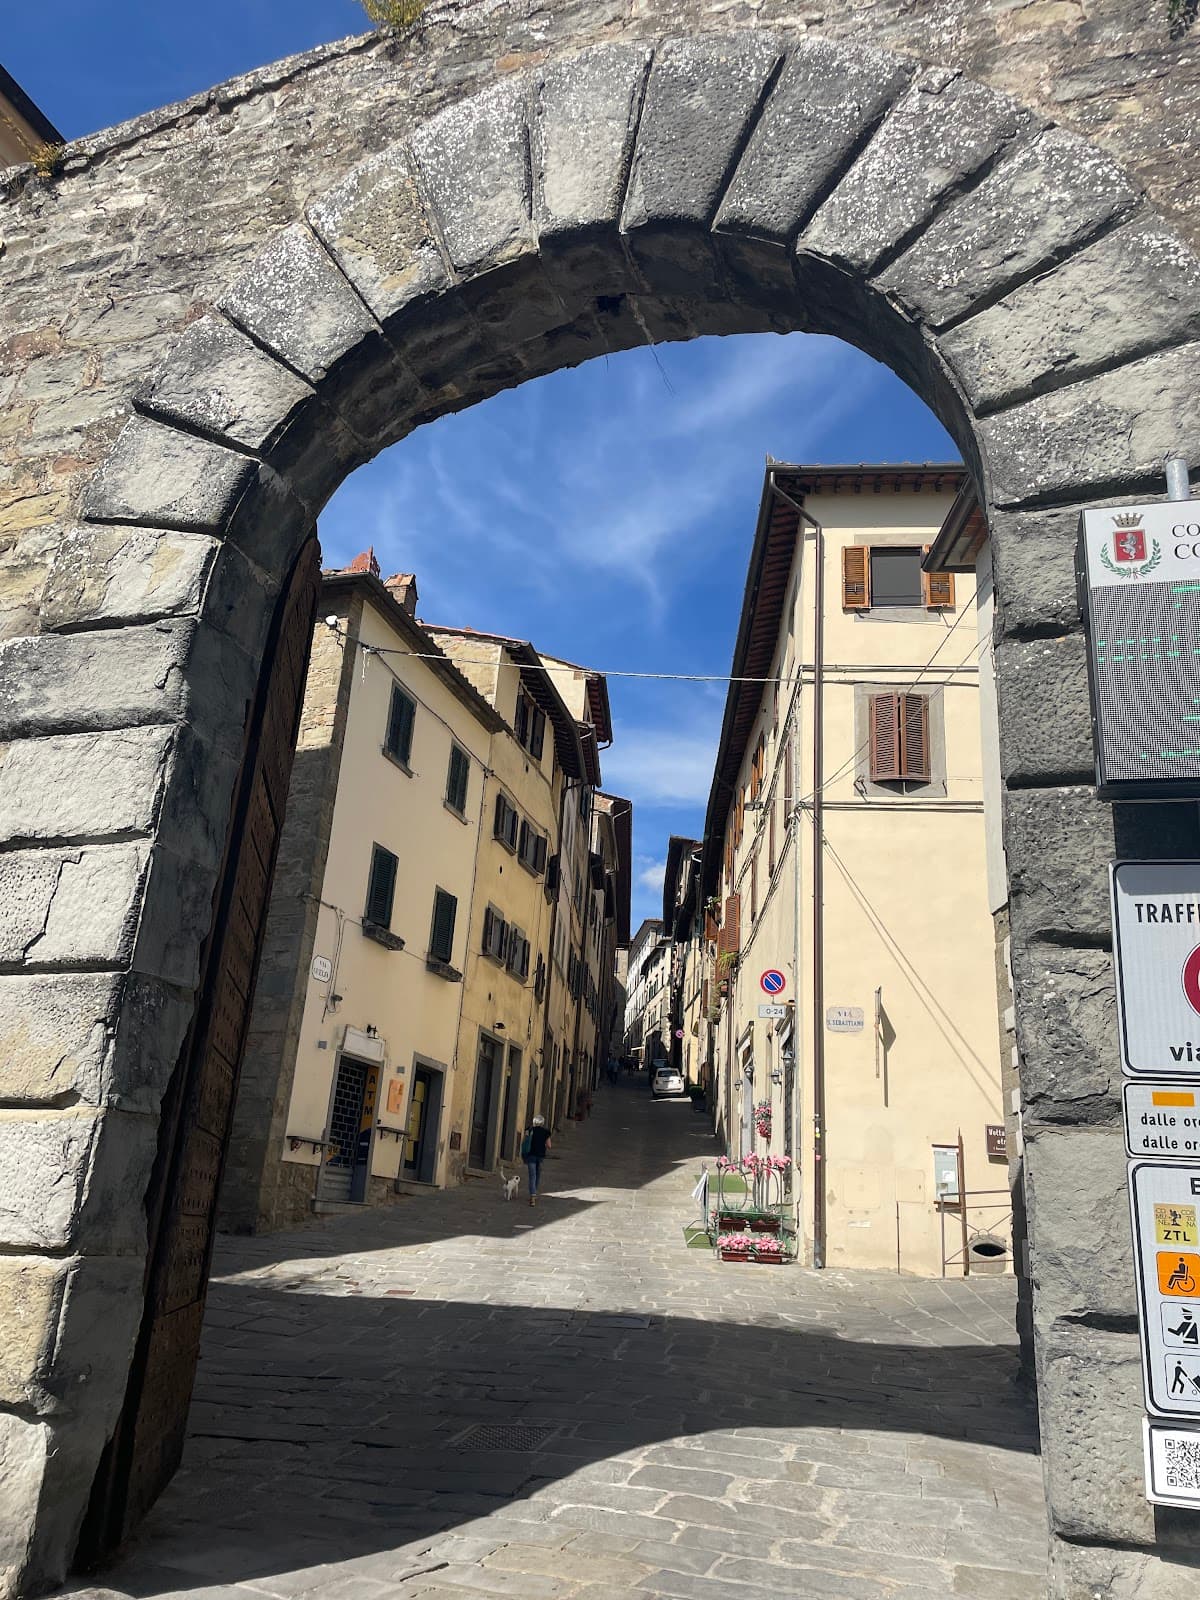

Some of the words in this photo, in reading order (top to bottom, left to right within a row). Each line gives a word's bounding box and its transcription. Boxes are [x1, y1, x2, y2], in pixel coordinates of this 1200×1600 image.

[1141, 1113, 1176, 1127] dalle
[1143, 1135, 1178, 1149] dalle
[1163, 1229, 1191, 1242] ZTL
